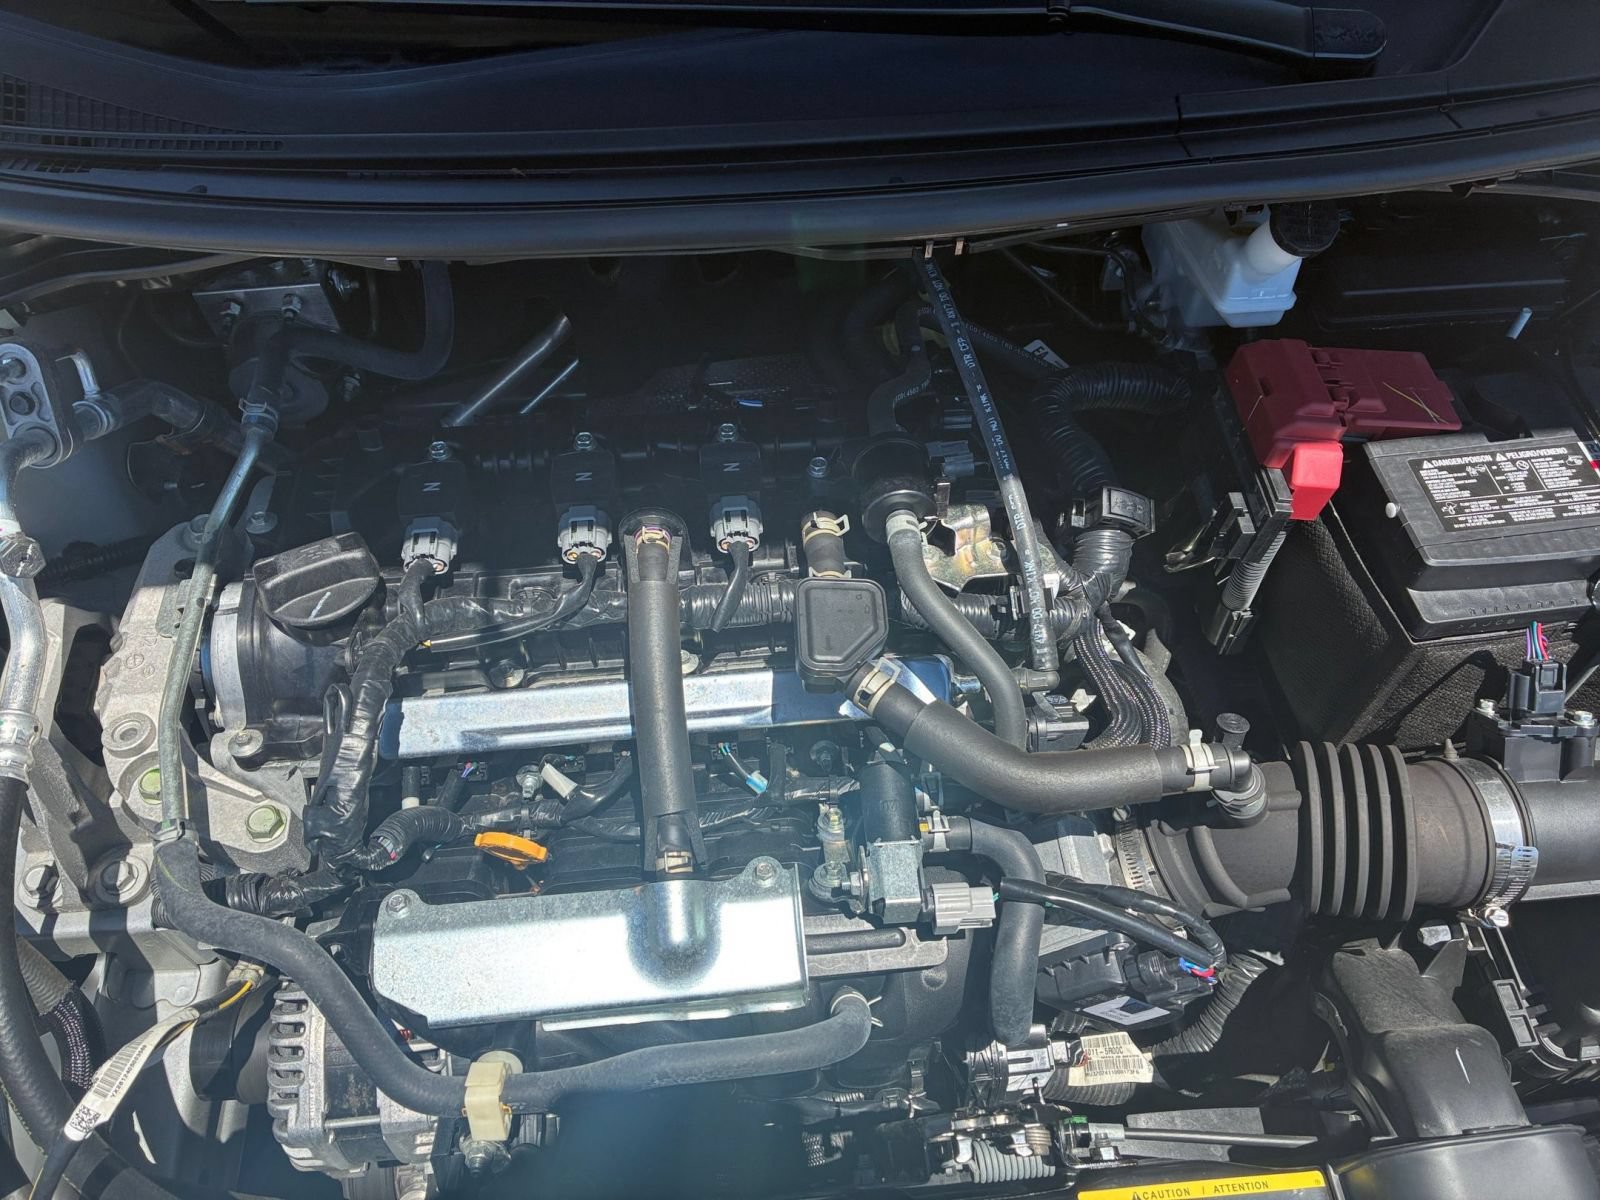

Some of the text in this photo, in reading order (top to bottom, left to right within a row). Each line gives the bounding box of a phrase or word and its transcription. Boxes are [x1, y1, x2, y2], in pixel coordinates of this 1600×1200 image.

[1432, 455, 1493, 467] DANGER/POISON
[1505, 447, 1568, 460] PELIGRO/VENENO
[1023, 559, 1037, 584] KINK
[1142, 1188, 1191, 1200] CAUTION
[1213, 1181, 1270, 1194] ATTENTION
